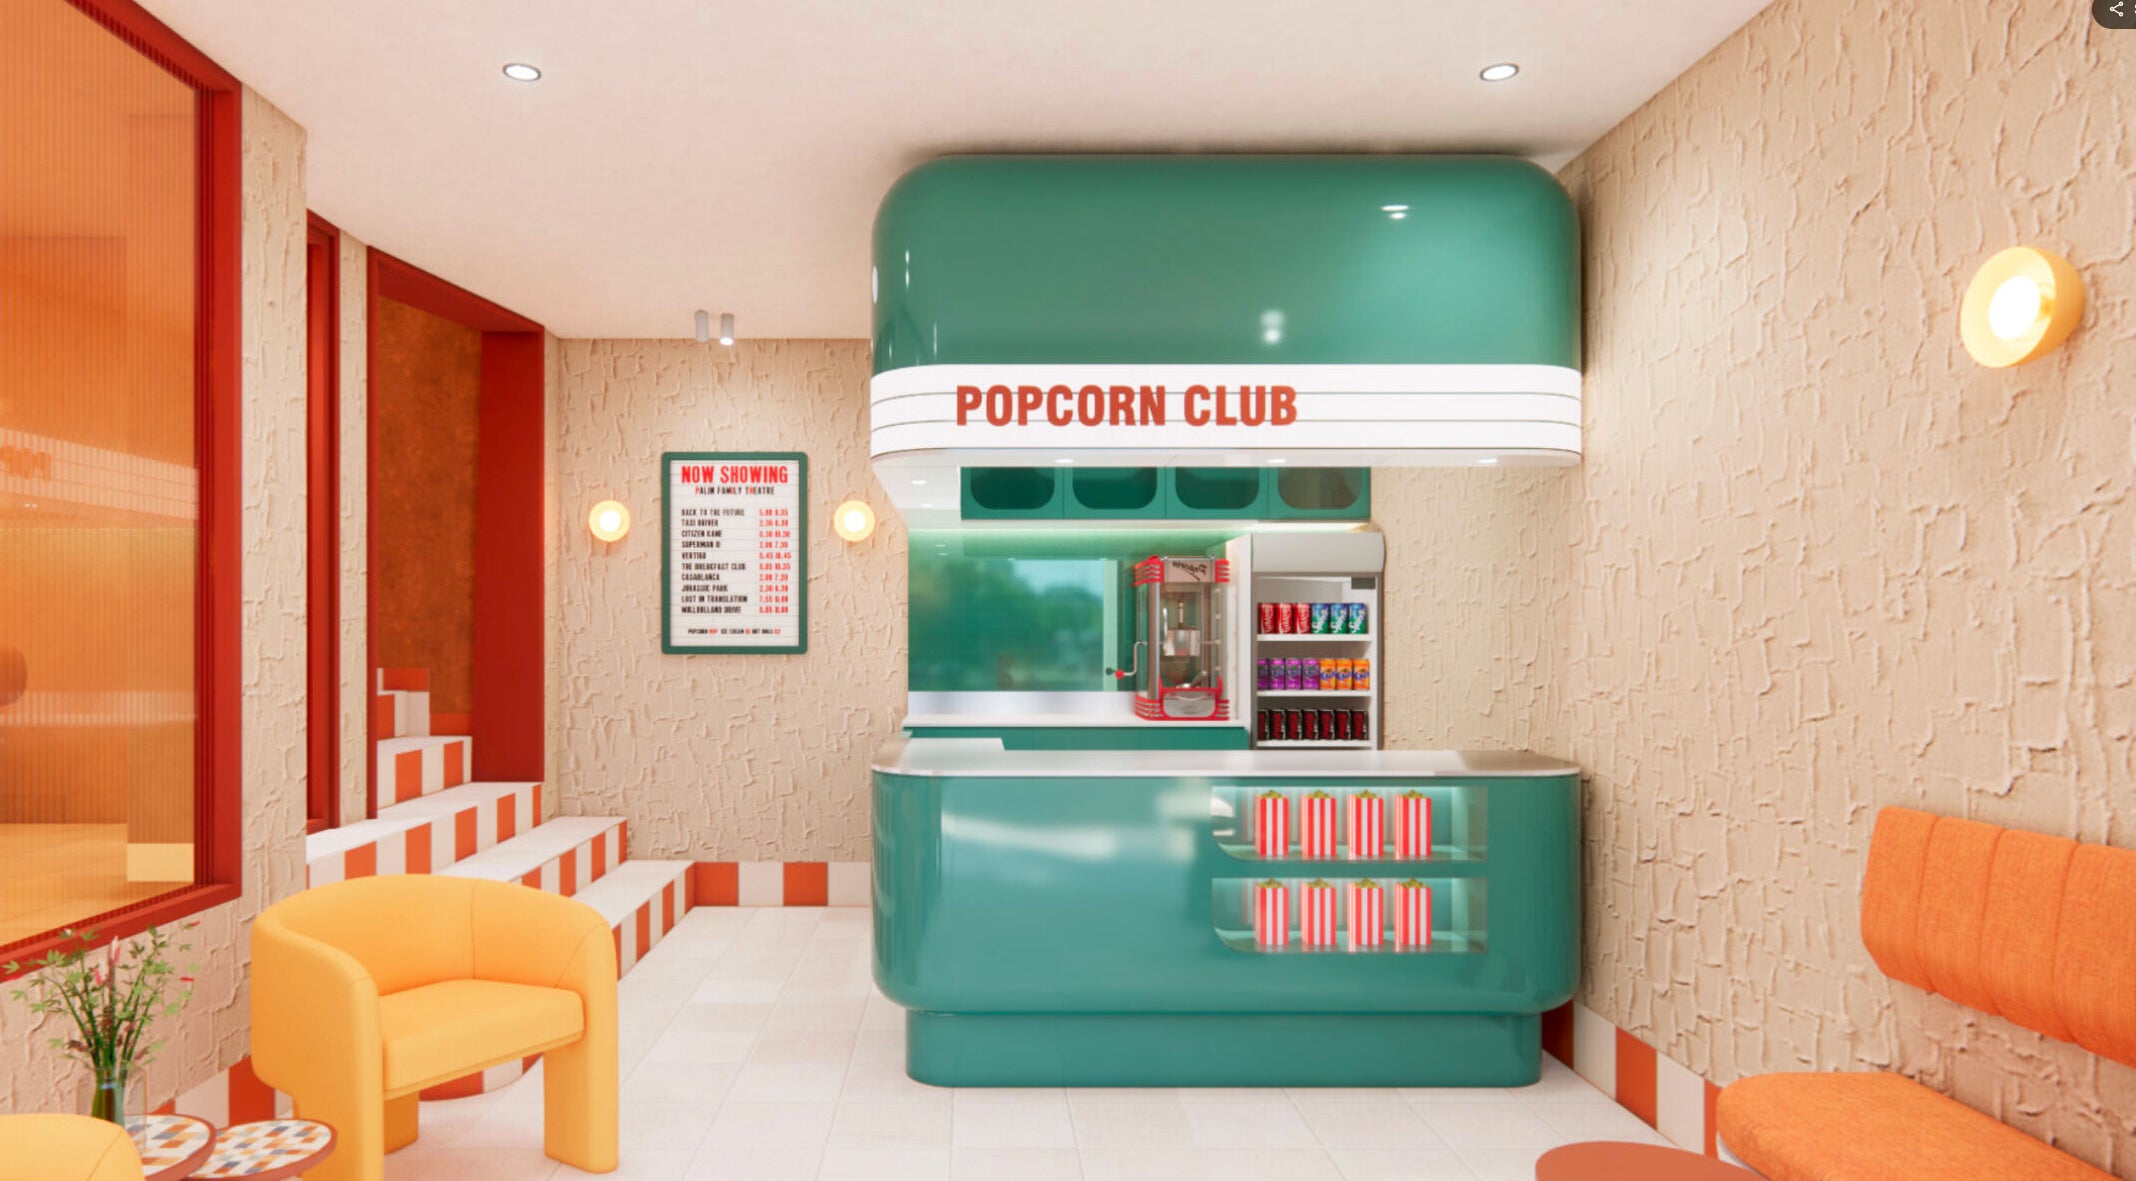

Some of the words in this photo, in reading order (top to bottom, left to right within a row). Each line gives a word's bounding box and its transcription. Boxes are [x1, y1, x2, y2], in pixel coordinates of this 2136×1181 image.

[955, 384, 1166, 427] POPCORN
[1184, 384, 1298, 427] CLUB
[681, 466, 714, 483] NOW
[720, 466, 788, 483] SHOWING
